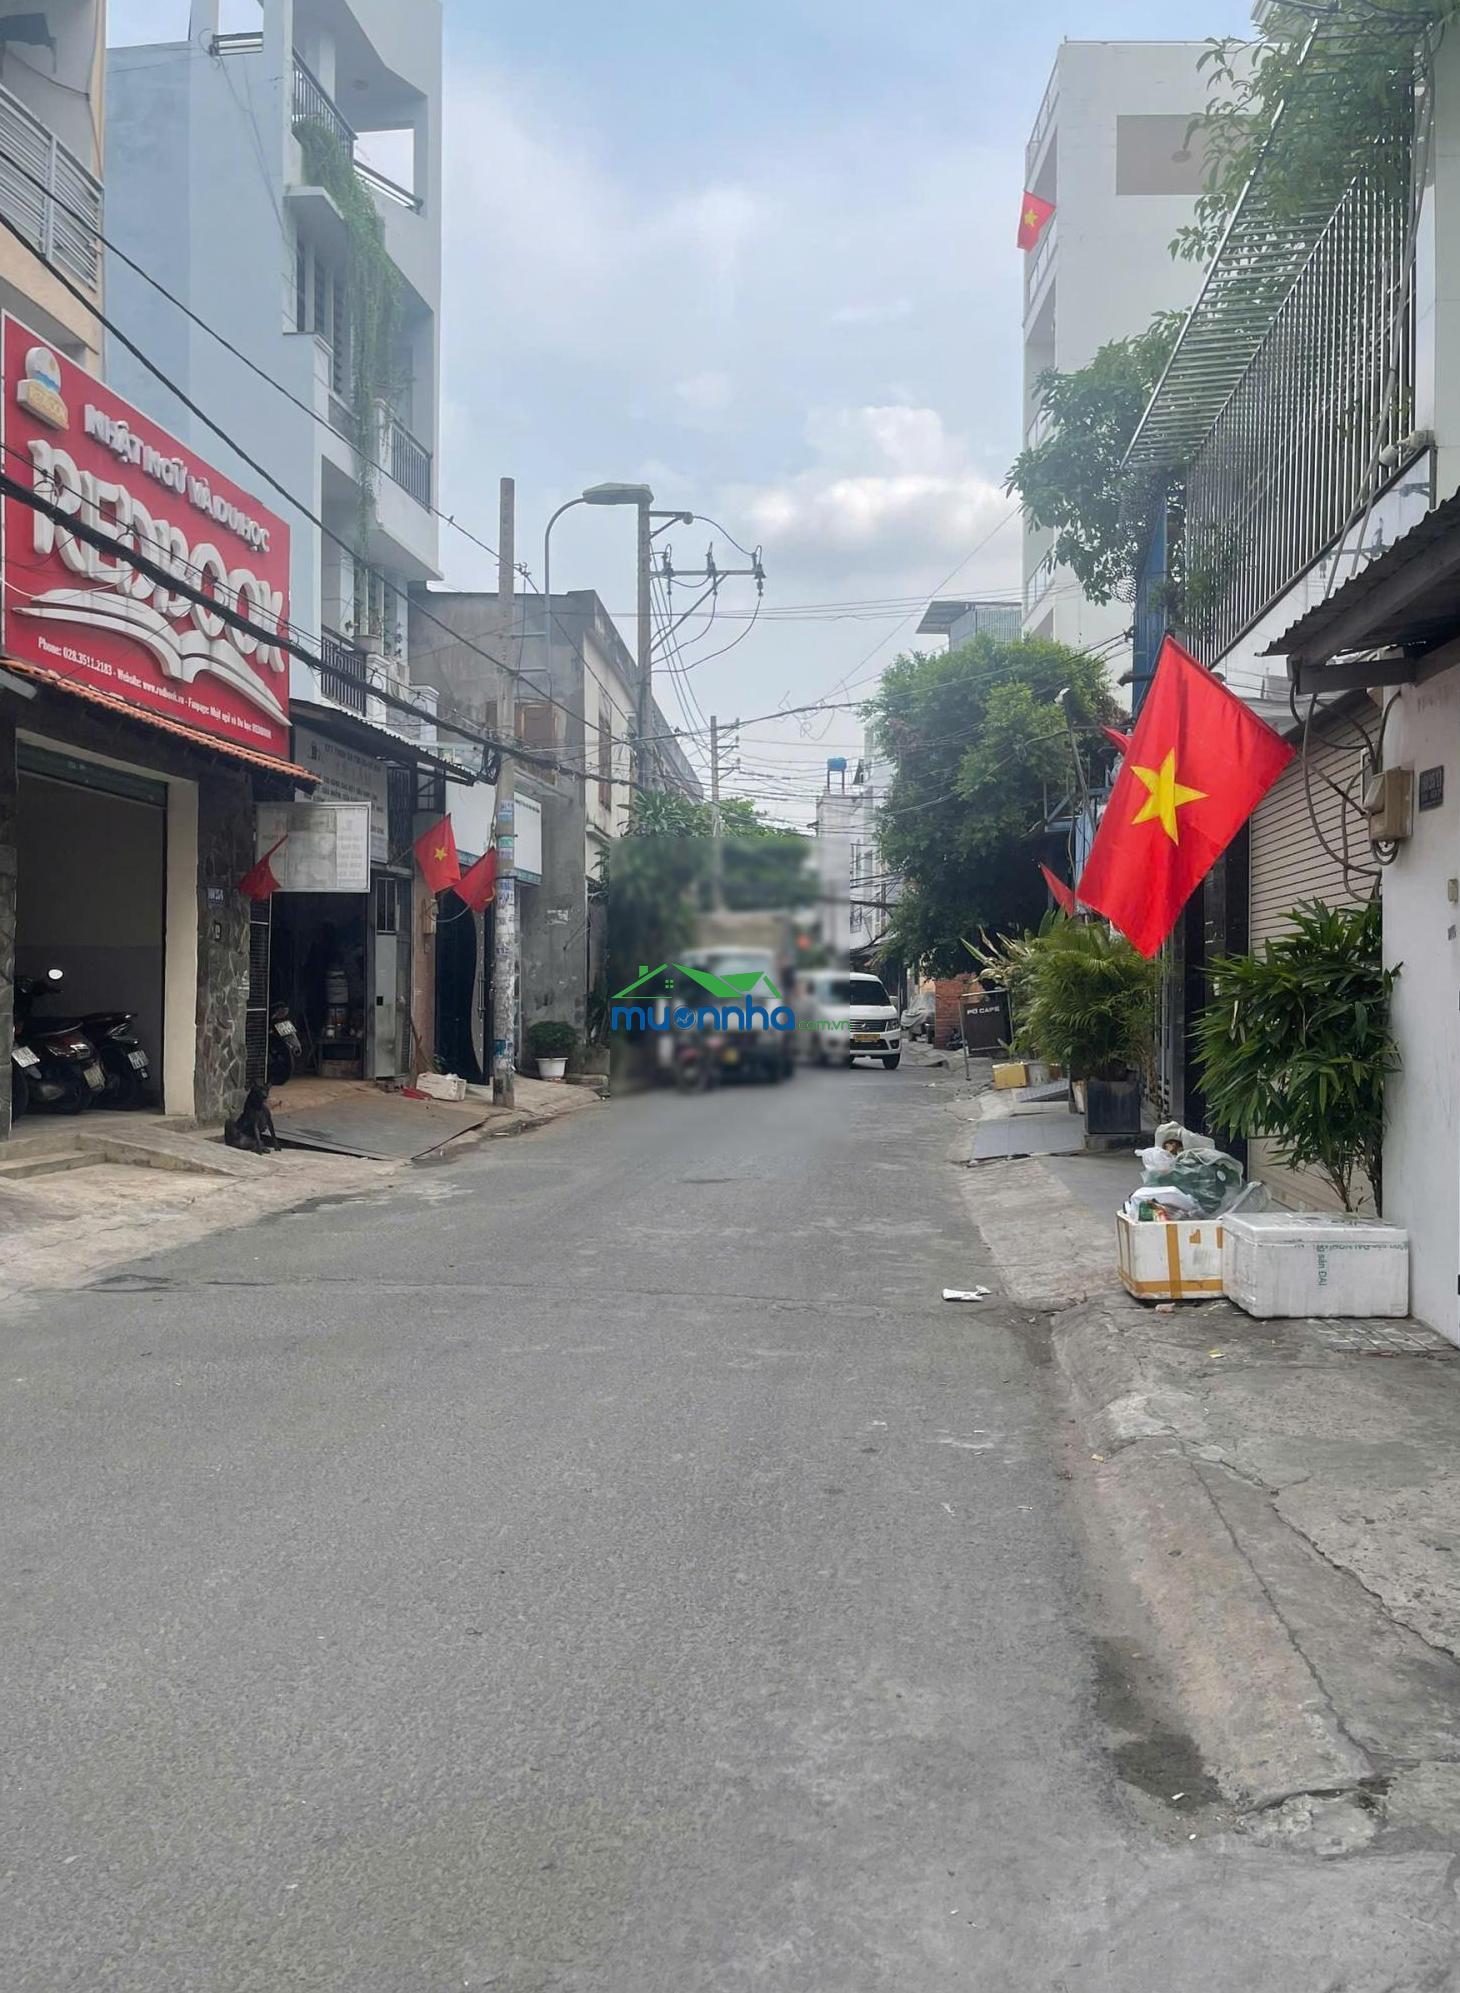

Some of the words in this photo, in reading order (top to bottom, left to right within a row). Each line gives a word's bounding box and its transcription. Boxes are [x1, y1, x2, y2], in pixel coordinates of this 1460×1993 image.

[84, 403, 144, 465] NHẬT
[27, 439, 285, 673] REDBOOK
[38, 636, 62, 657] Phone:
[62, 646, 113, 677] 028.3511.2183
